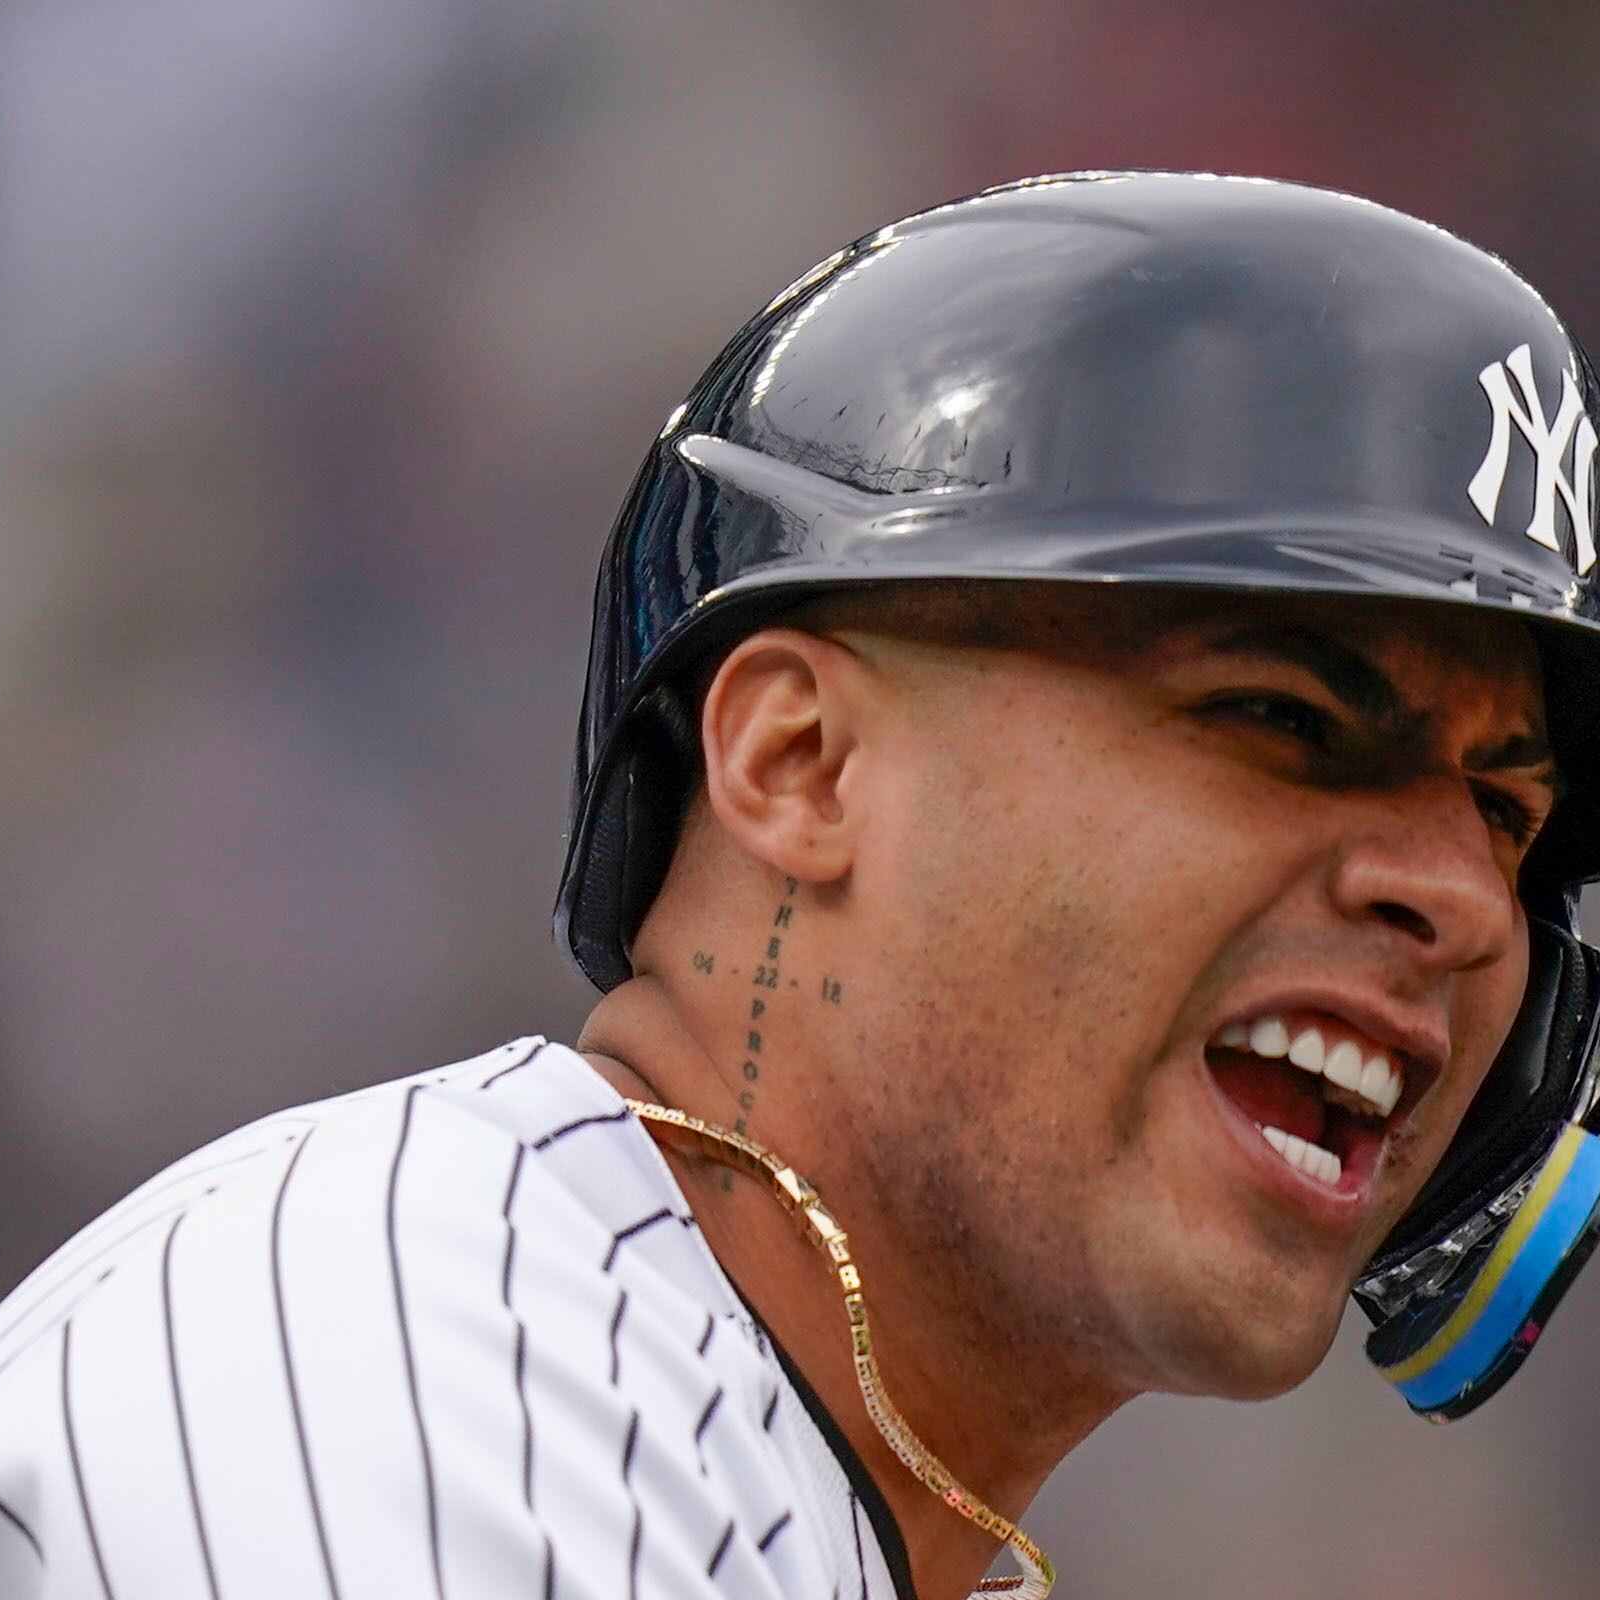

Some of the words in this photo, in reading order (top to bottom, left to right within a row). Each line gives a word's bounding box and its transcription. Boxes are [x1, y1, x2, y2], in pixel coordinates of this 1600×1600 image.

[1466, 343, 1600, 577] NY
[766, 875, 799, 960] THE
[753, 964, 779, 989] 22
